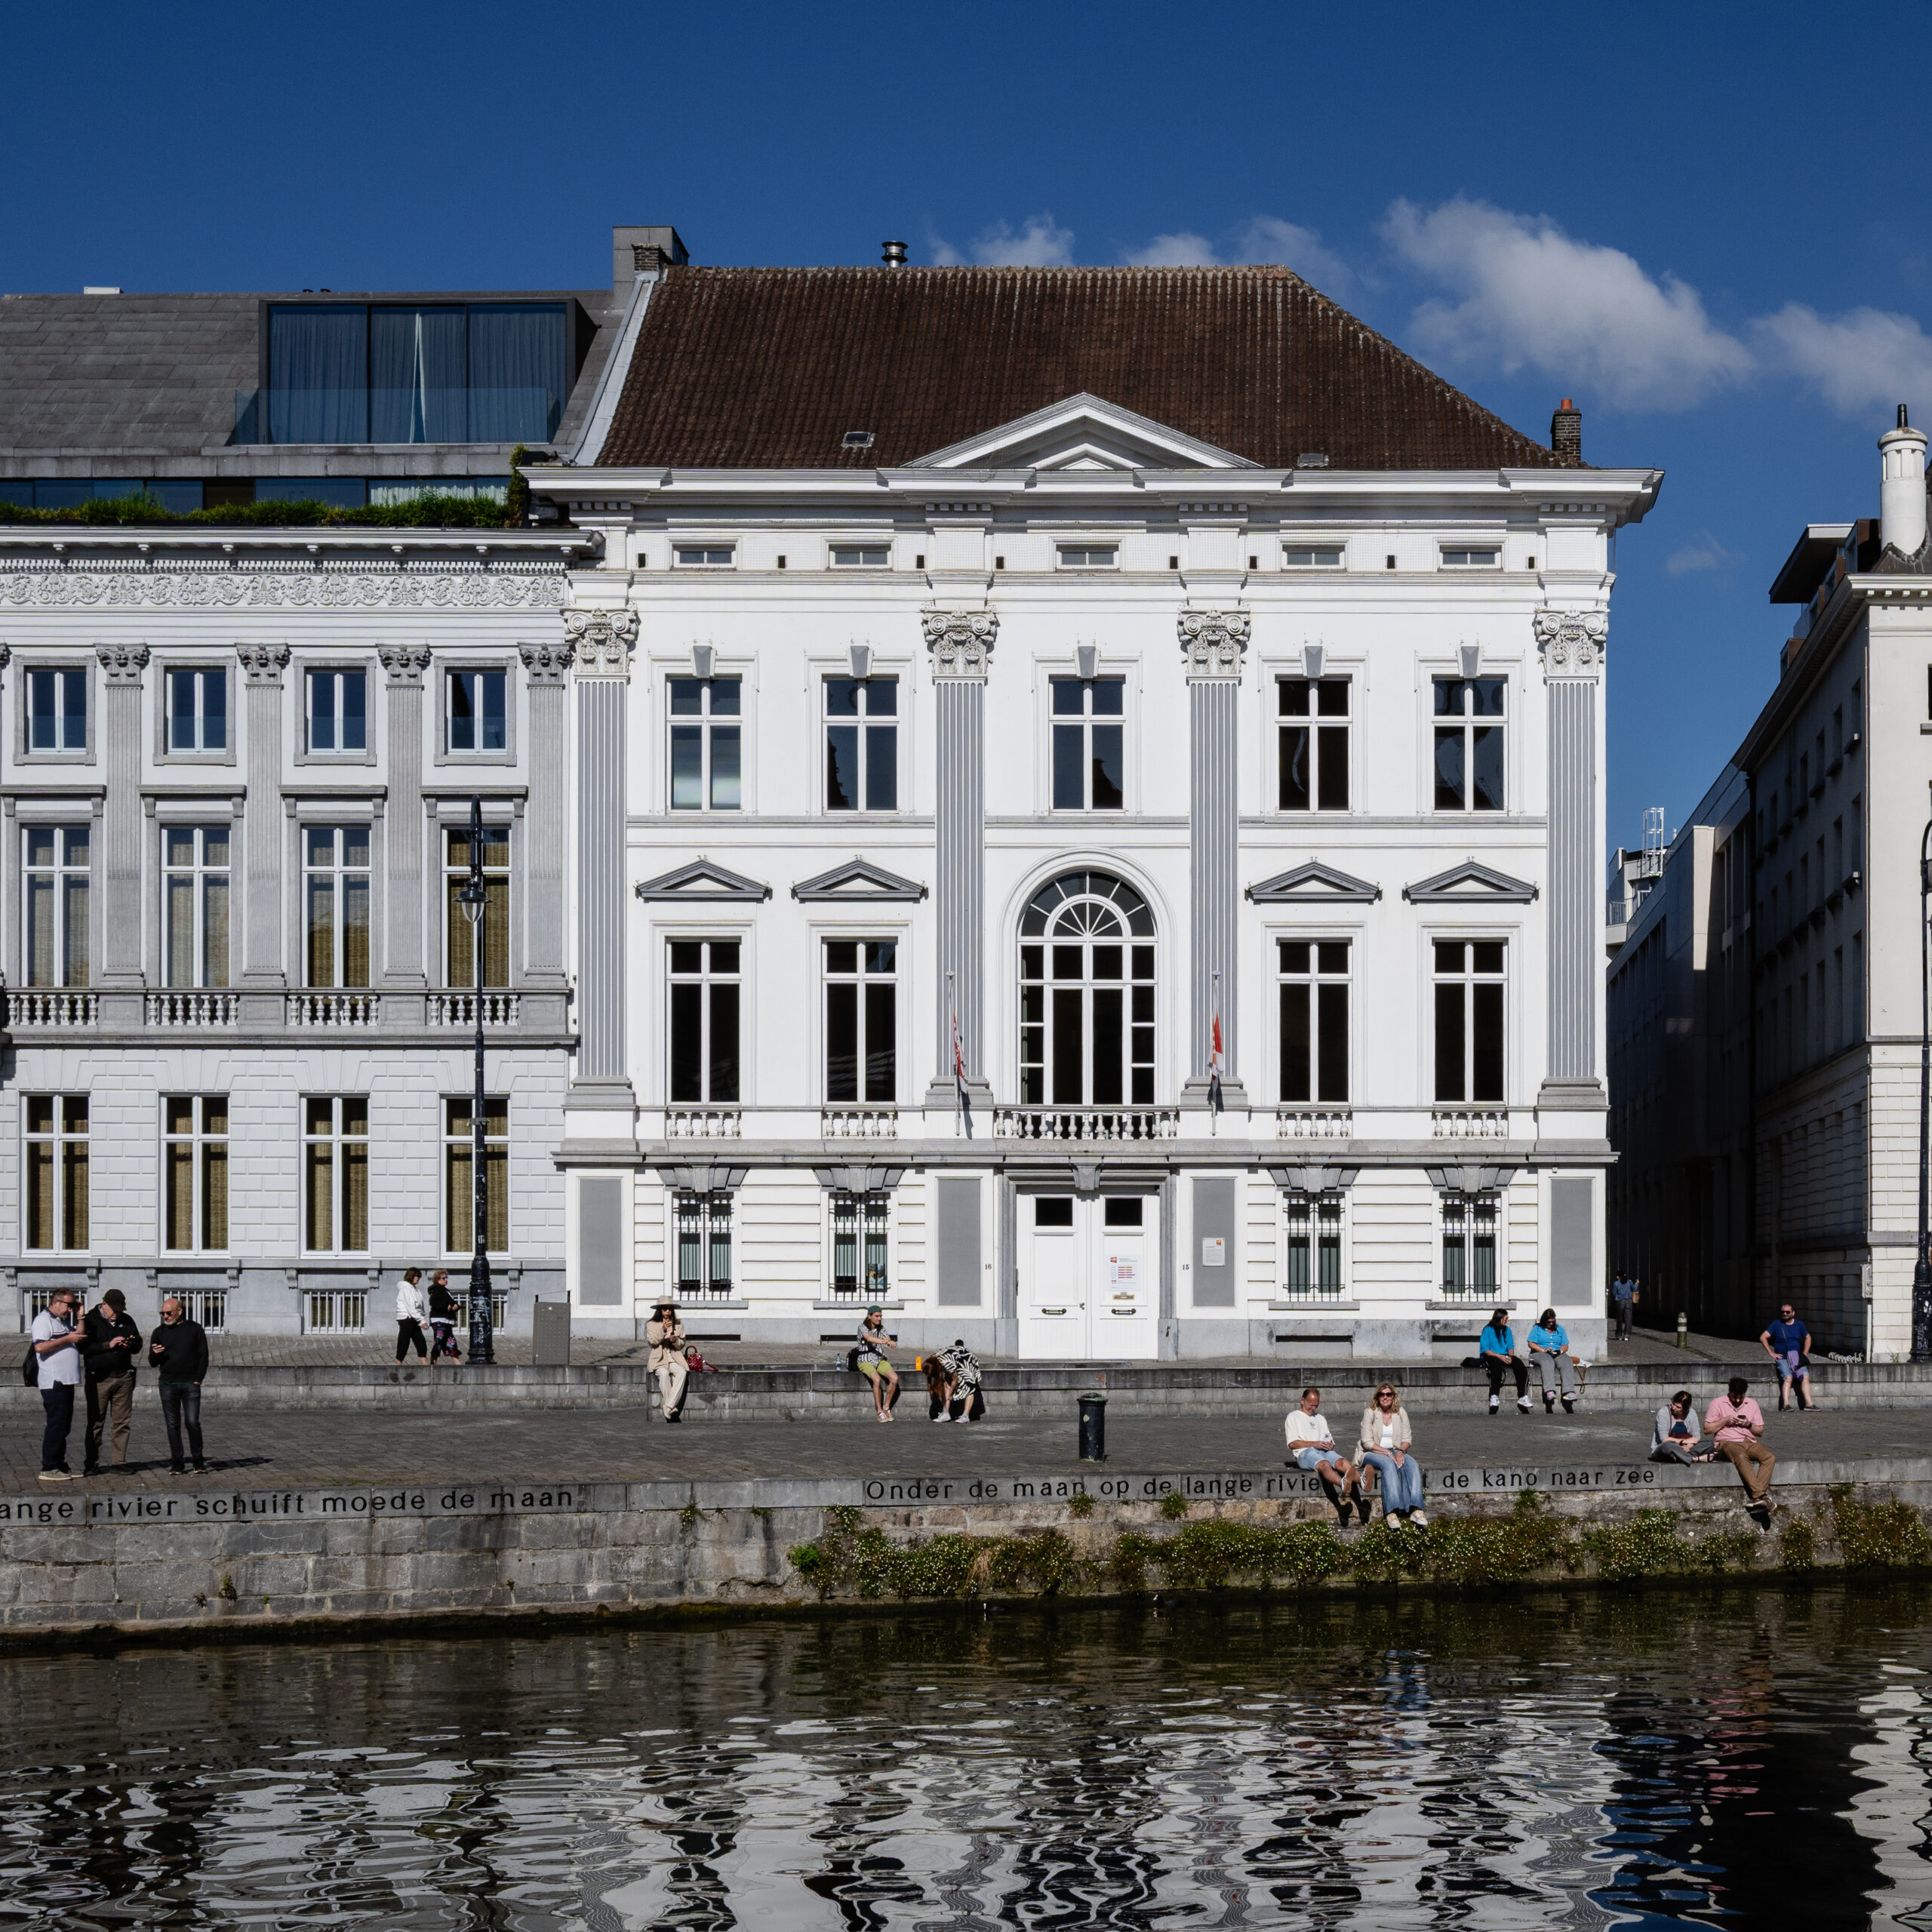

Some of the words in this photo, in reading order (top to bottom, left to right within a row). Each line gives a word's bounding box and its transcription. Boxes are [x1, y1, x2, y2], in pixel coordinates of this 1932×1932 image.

[866, 1481, 953, 1500] Onder
[968, 1481, 998, 1498] de
[1013, 1481, 1085, 1497] maan
[1100, 1480, 1130, 1499] op
[1143, 1478, 1173, 1495] de
[1186, 1476, 1253, 1497] lange
[1266, 1474, 1320, 1492] rivie
[1442, 1472, 1469, 1488] de
[1482, 1469, 1537, 1487] kano
[1551, 1472, 1604, 1486] naar
[1615, 1469, 1655, 1484] zee
[91, 1497, 179, 1518] rivier
[195, 1494, 304, 1515] schuift
[321, 1491, 425, 1512] moede
[440, 1491, 475, 1509] de
[490, 1491, 572, 1508] maan
